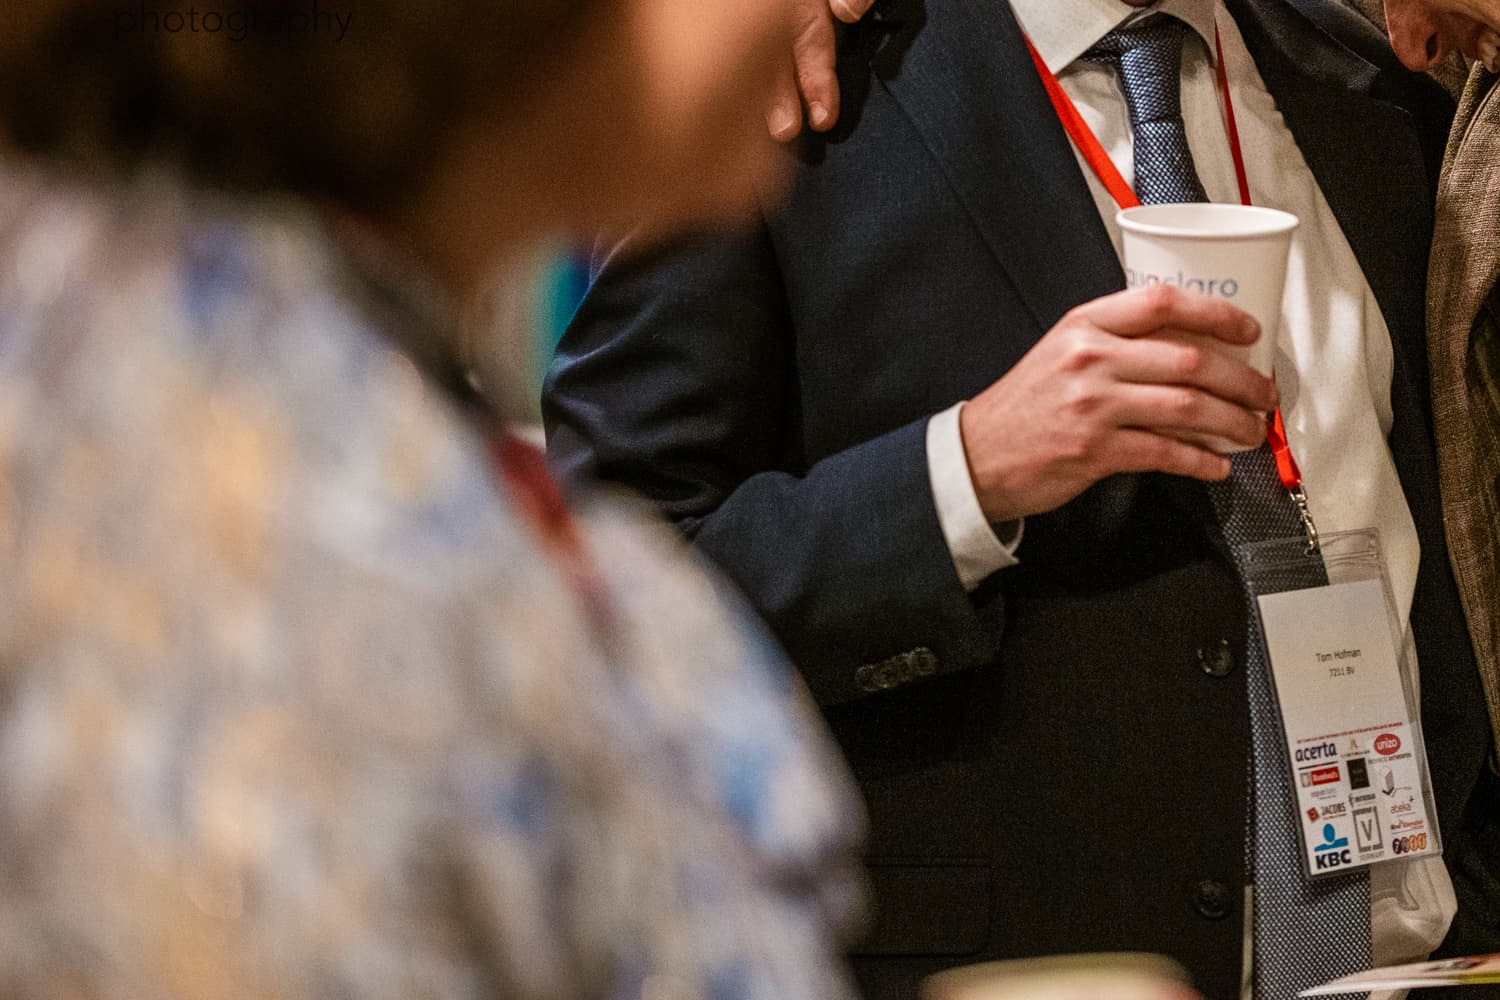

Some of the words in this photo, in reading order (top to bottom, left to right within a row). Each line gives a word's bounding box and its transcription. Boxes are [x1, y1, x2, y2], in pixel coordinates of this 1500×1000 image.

[1296, 741, 1338, 762] acerta
[1376, 737, 1398, 750] unizo
[1315, 849, 1352, 870] KBC
